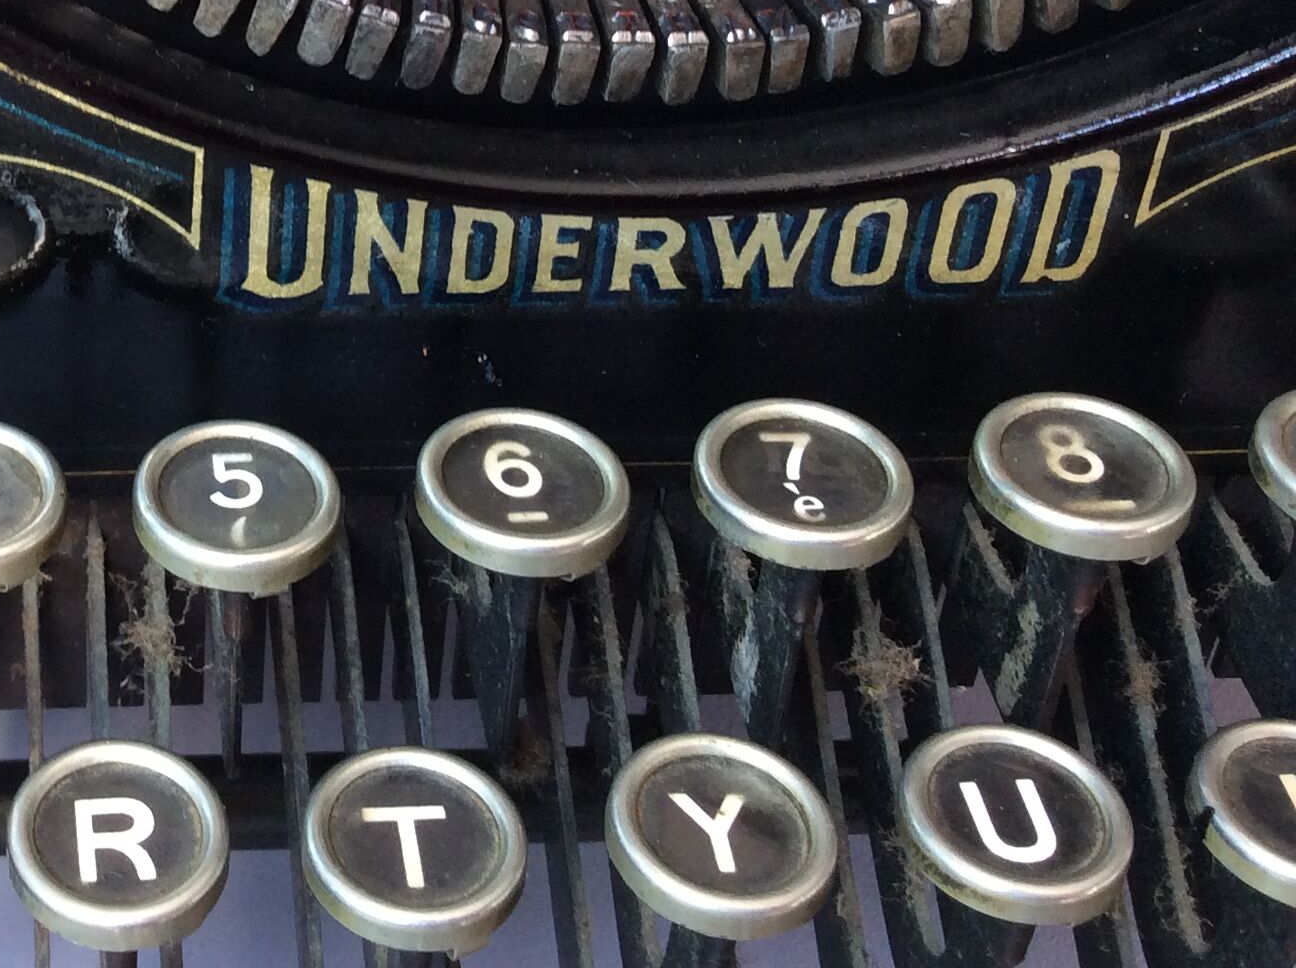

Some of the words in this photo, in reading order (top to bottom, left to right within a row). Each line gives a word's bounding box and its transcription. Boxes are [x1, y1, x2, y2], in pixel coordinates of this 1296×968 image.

[224, 149, 1120, 305] UNDERWOOD
[209, 452, 264, 509] 5
[484, 441, 543, 498] 6
[759, 433, 811, 481] 7
[1036, 423, 1105, 484] 8
[73, 797, 158, 884] R
[361, 805, 446, 889] T
[667, 793, 745, 874] Y
[958, 779, 1057, 863] U
